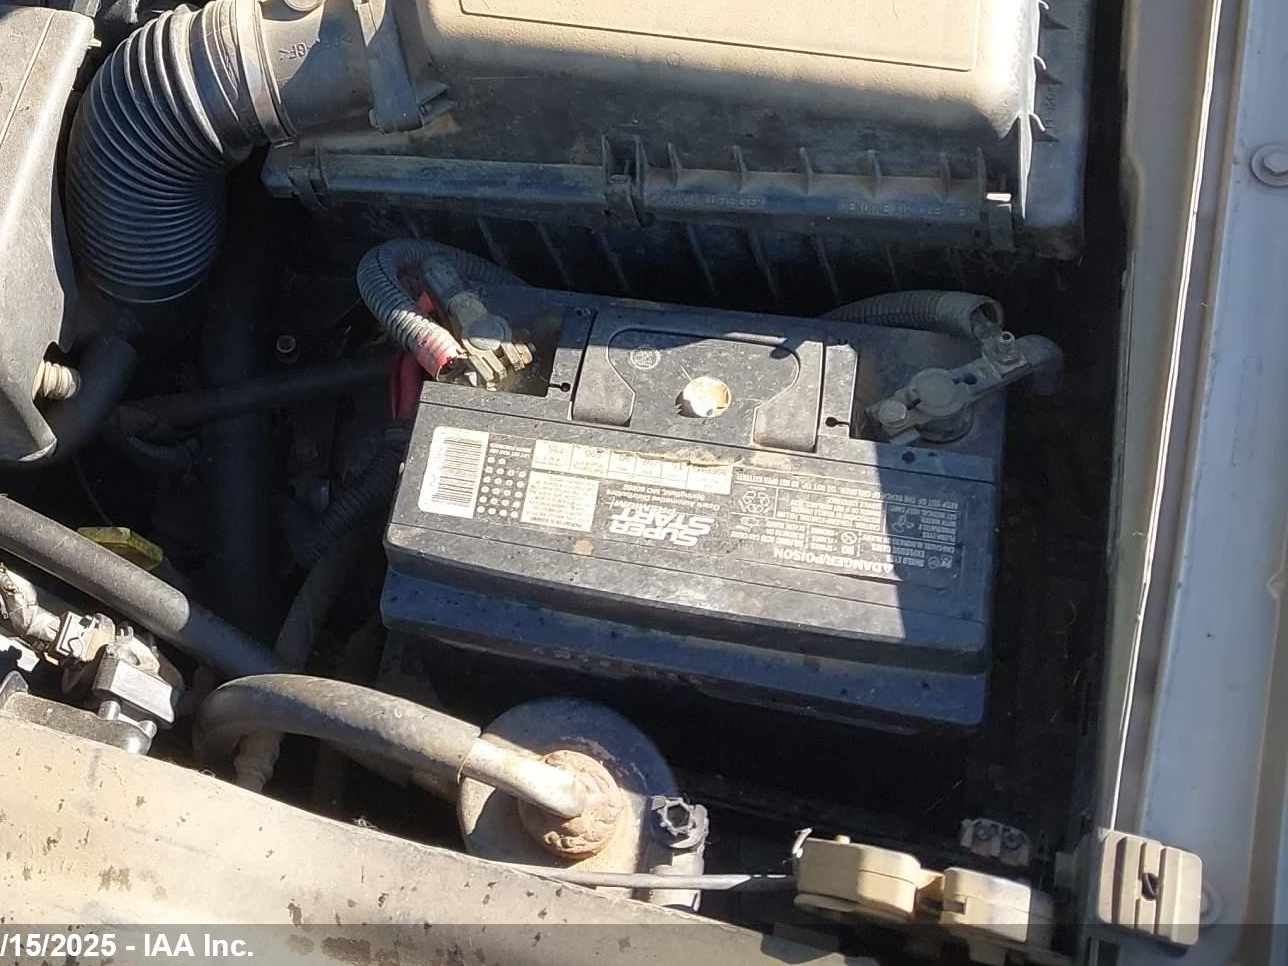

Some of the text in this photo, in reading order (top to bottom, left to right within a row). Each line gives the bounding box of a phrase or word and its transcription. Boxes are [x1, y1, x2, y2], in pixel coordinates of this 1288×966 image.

[608, 519, 699, 547] SUPER
[610, 504, 715, 536] START
[773, 547, 884, 573] DANGER/POISON
